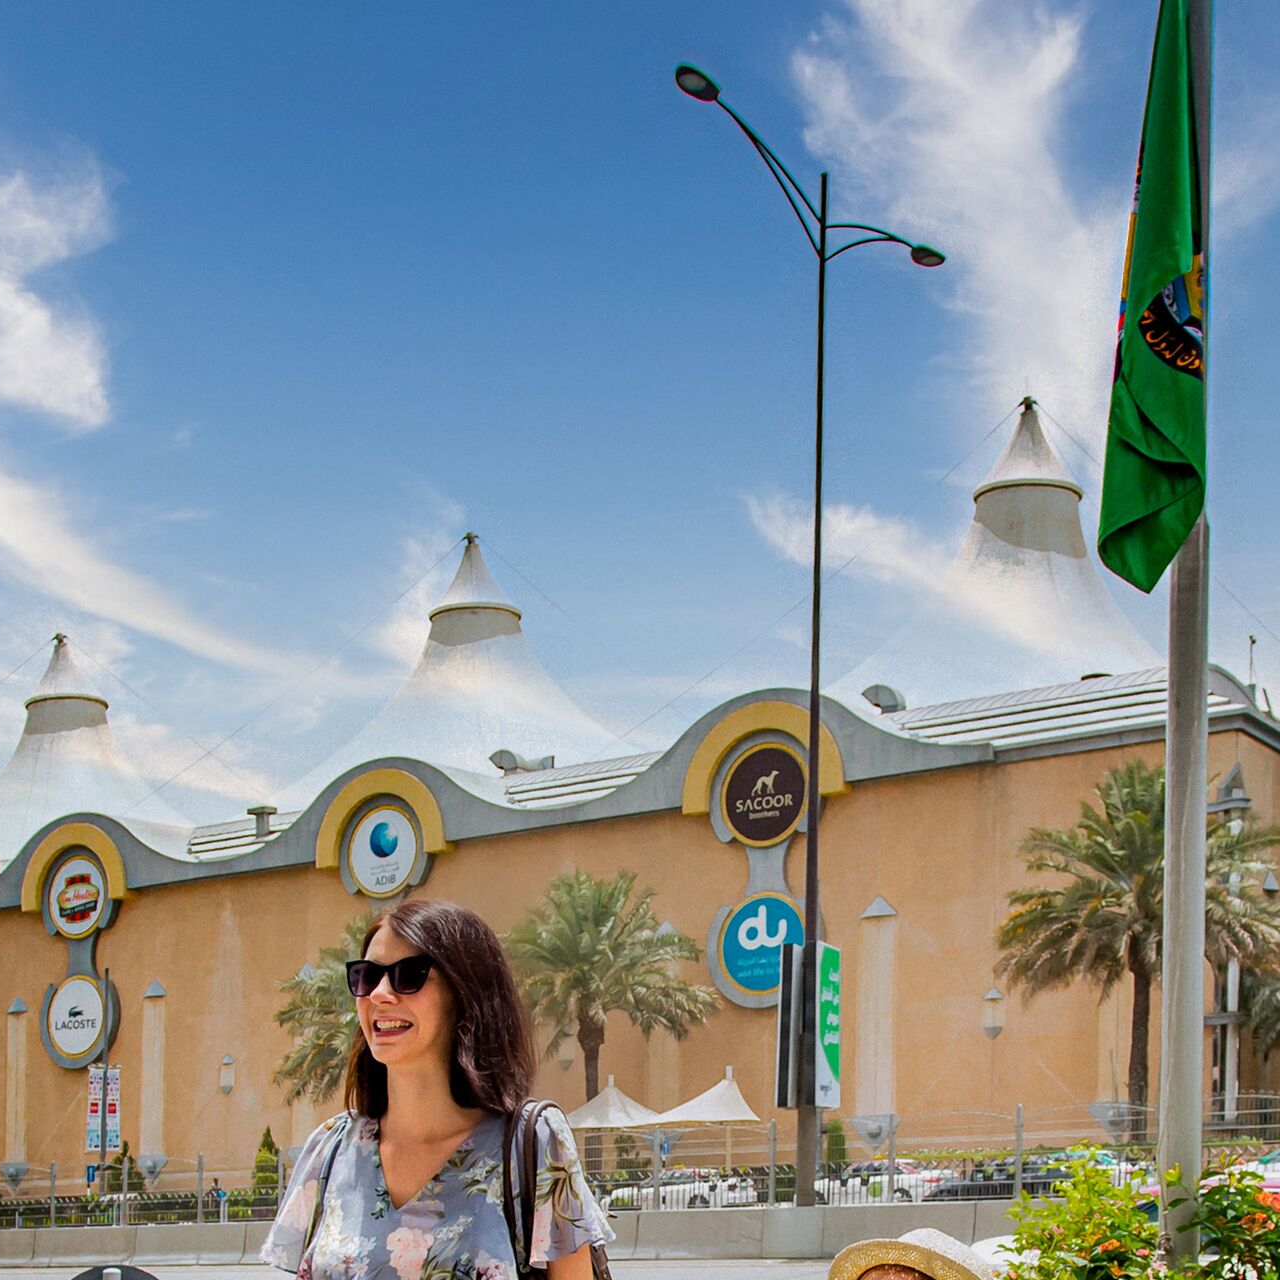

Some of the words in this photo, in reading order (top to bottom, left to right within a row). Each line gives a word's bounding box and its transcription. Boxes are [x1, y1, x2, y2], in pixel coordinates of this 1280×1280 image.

[735, 793, 794, 813] SACOOR
[374, 873, 397, 887] ADIB
[737, 904, 787, 951] du
[54, 1018, 97, 1031] LACOSTE
